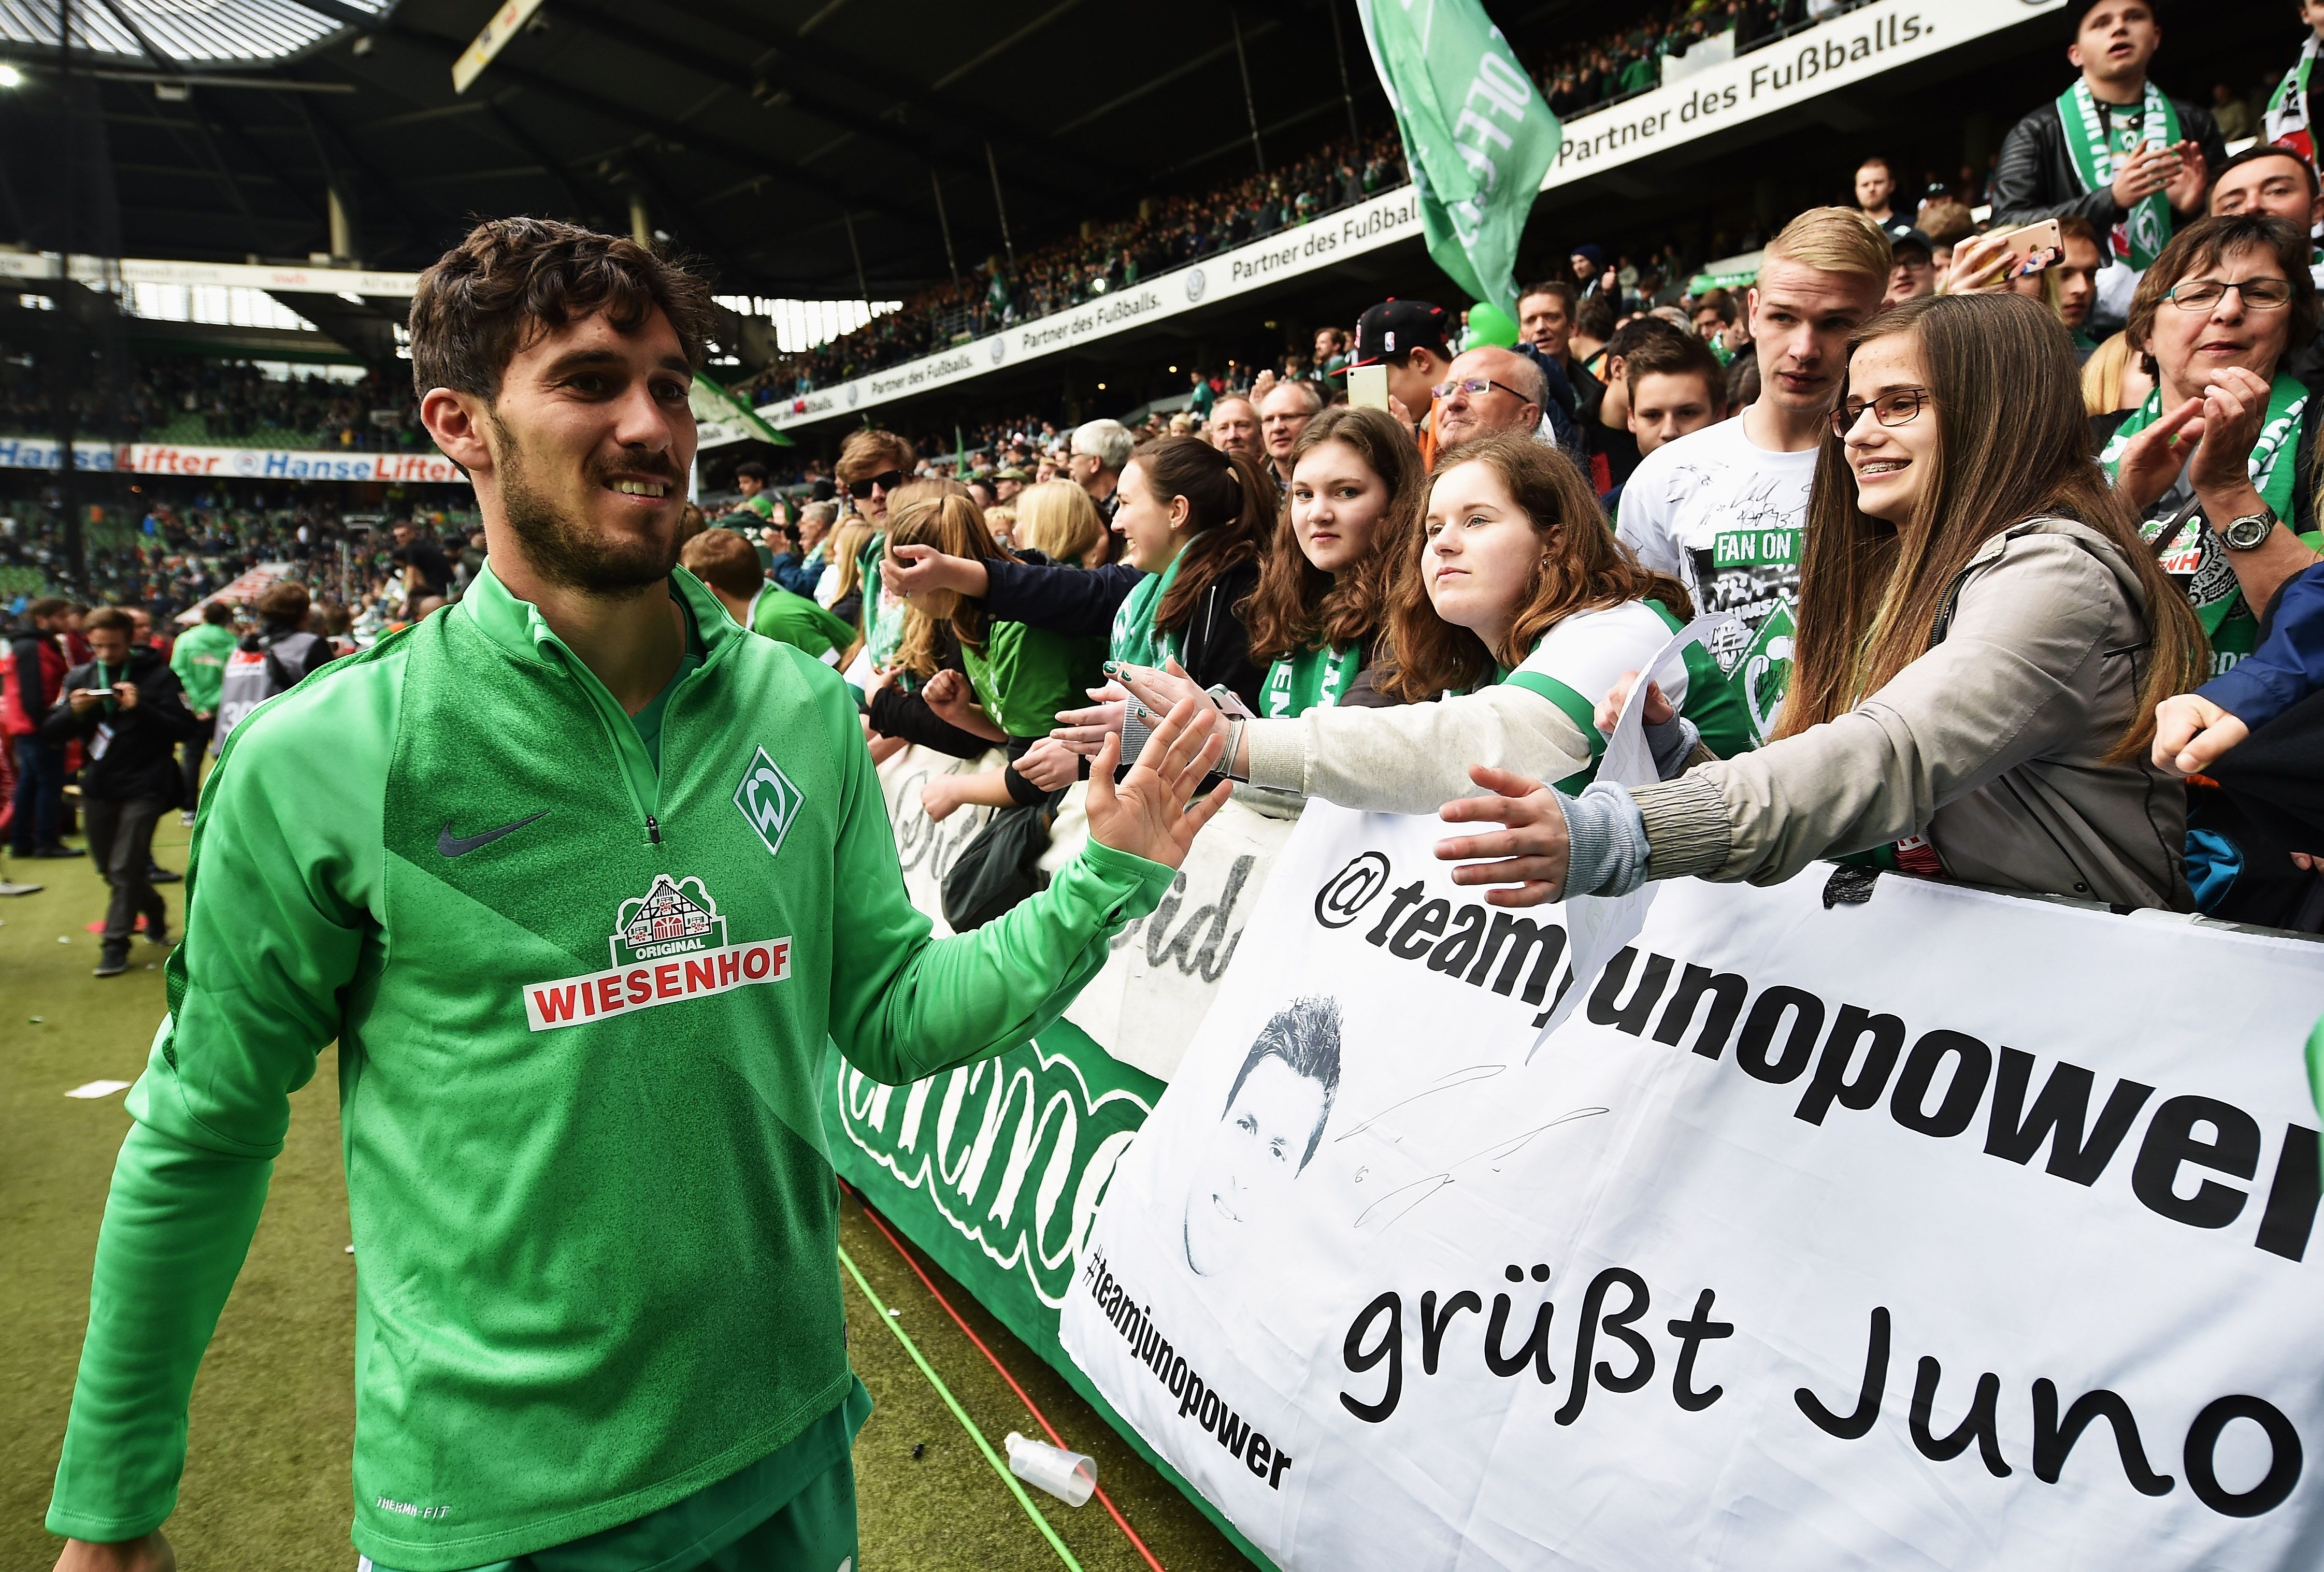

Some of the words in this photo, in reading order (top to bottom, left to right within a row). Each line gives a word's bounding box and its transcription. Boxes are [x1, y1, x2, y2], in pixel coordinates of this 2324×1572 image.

[1559, 109, 1671, 167] Partner
[1681, 85, 1738, 124] des
[1749, 12, 1935, 99] Fußballs.
[1232, 243, 1298, 282] Partner
[1304, 232, 1337, 257] des
[1343, 196, 1418, 244] Fußbal
[1022, 320, 1068, 350] Partner
[1072, 314, 1094, 335] des
[1097, 291, 1162, 327] Fußballs.
[1718, 533, 1756, 562] FAN
[1762, 532, 1791, 559] ON
[533, 943, 789, 1024] WIESENHOF
[635, 938, 706, 960] ORIGINAL
[1082, 1244, 1293, 1491] #teamjunopower
[1340, 1263, 1734, 1426] grüßt
[1794, 1305, 2304, 1519] Juno
[376, 1495, 450, 1519] THERMA-FIT
